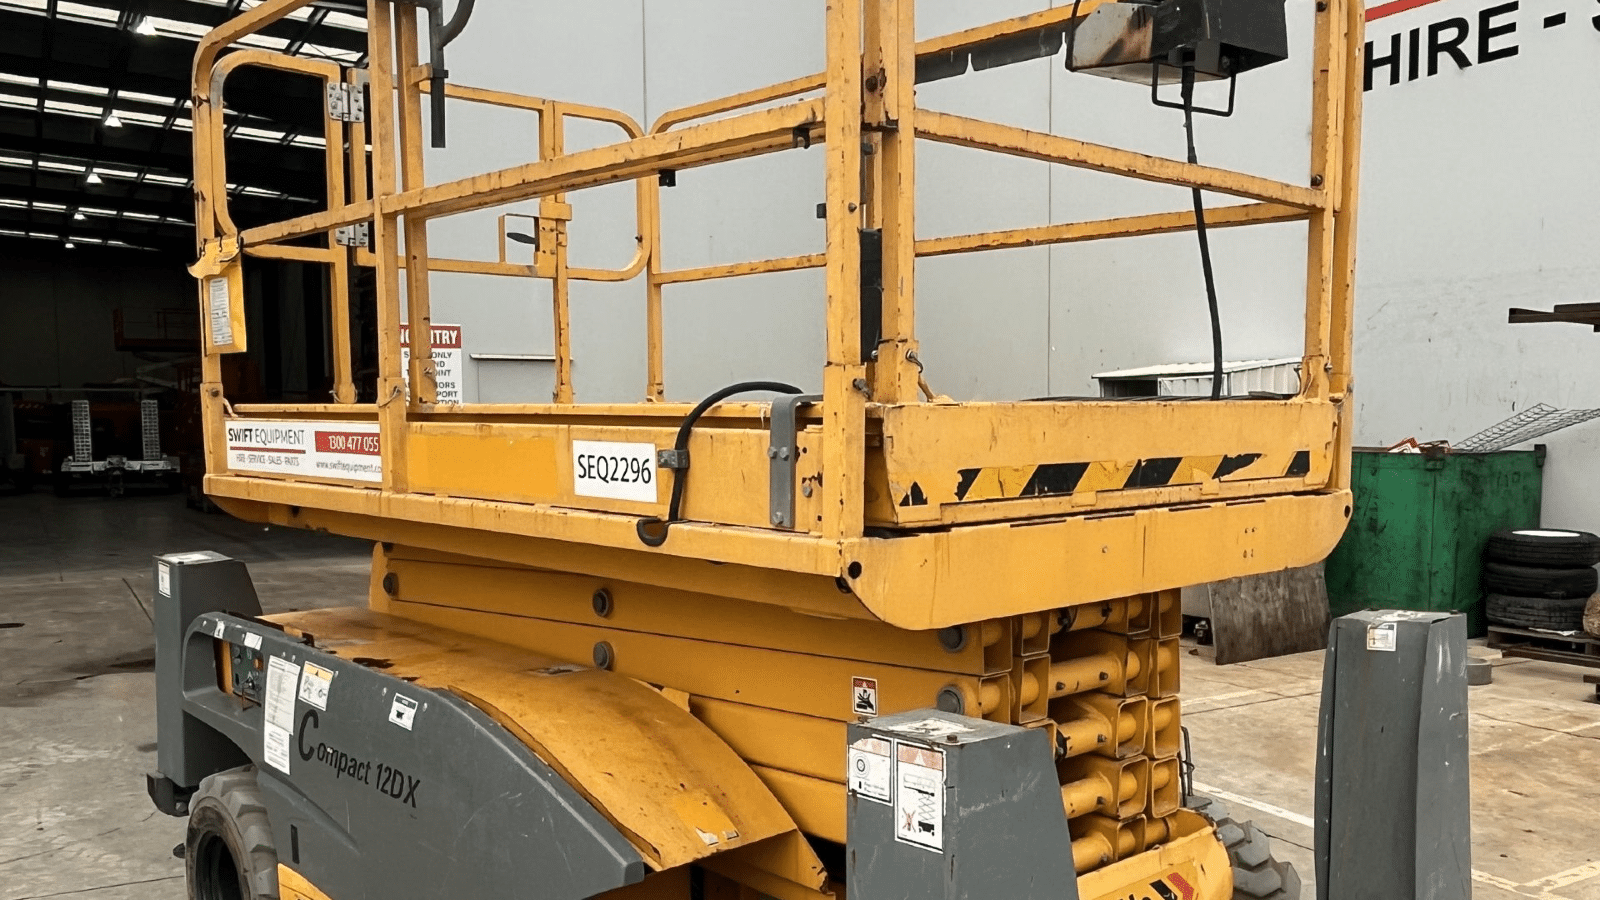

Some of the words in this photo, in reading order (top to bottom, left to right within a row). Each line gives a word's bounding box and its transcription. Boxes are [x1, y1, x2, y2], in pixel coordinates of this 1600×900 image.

[1363, 0, 1519, 92] HIRE
[431, 330, 458, 345] TRY
[228, 428, 253, 442] SWIFT
[255, 429, 304, 445] EQUIPMENT
[329, 435, 346, 450] 1300
[347, 436, 362, 451] 477
[363, 437, 379, 452] 055
[578, 454, 651, 484] SEQ2296
[298, 709, 371, 785] Compact
[376, 763, 420, 808] 12DX
